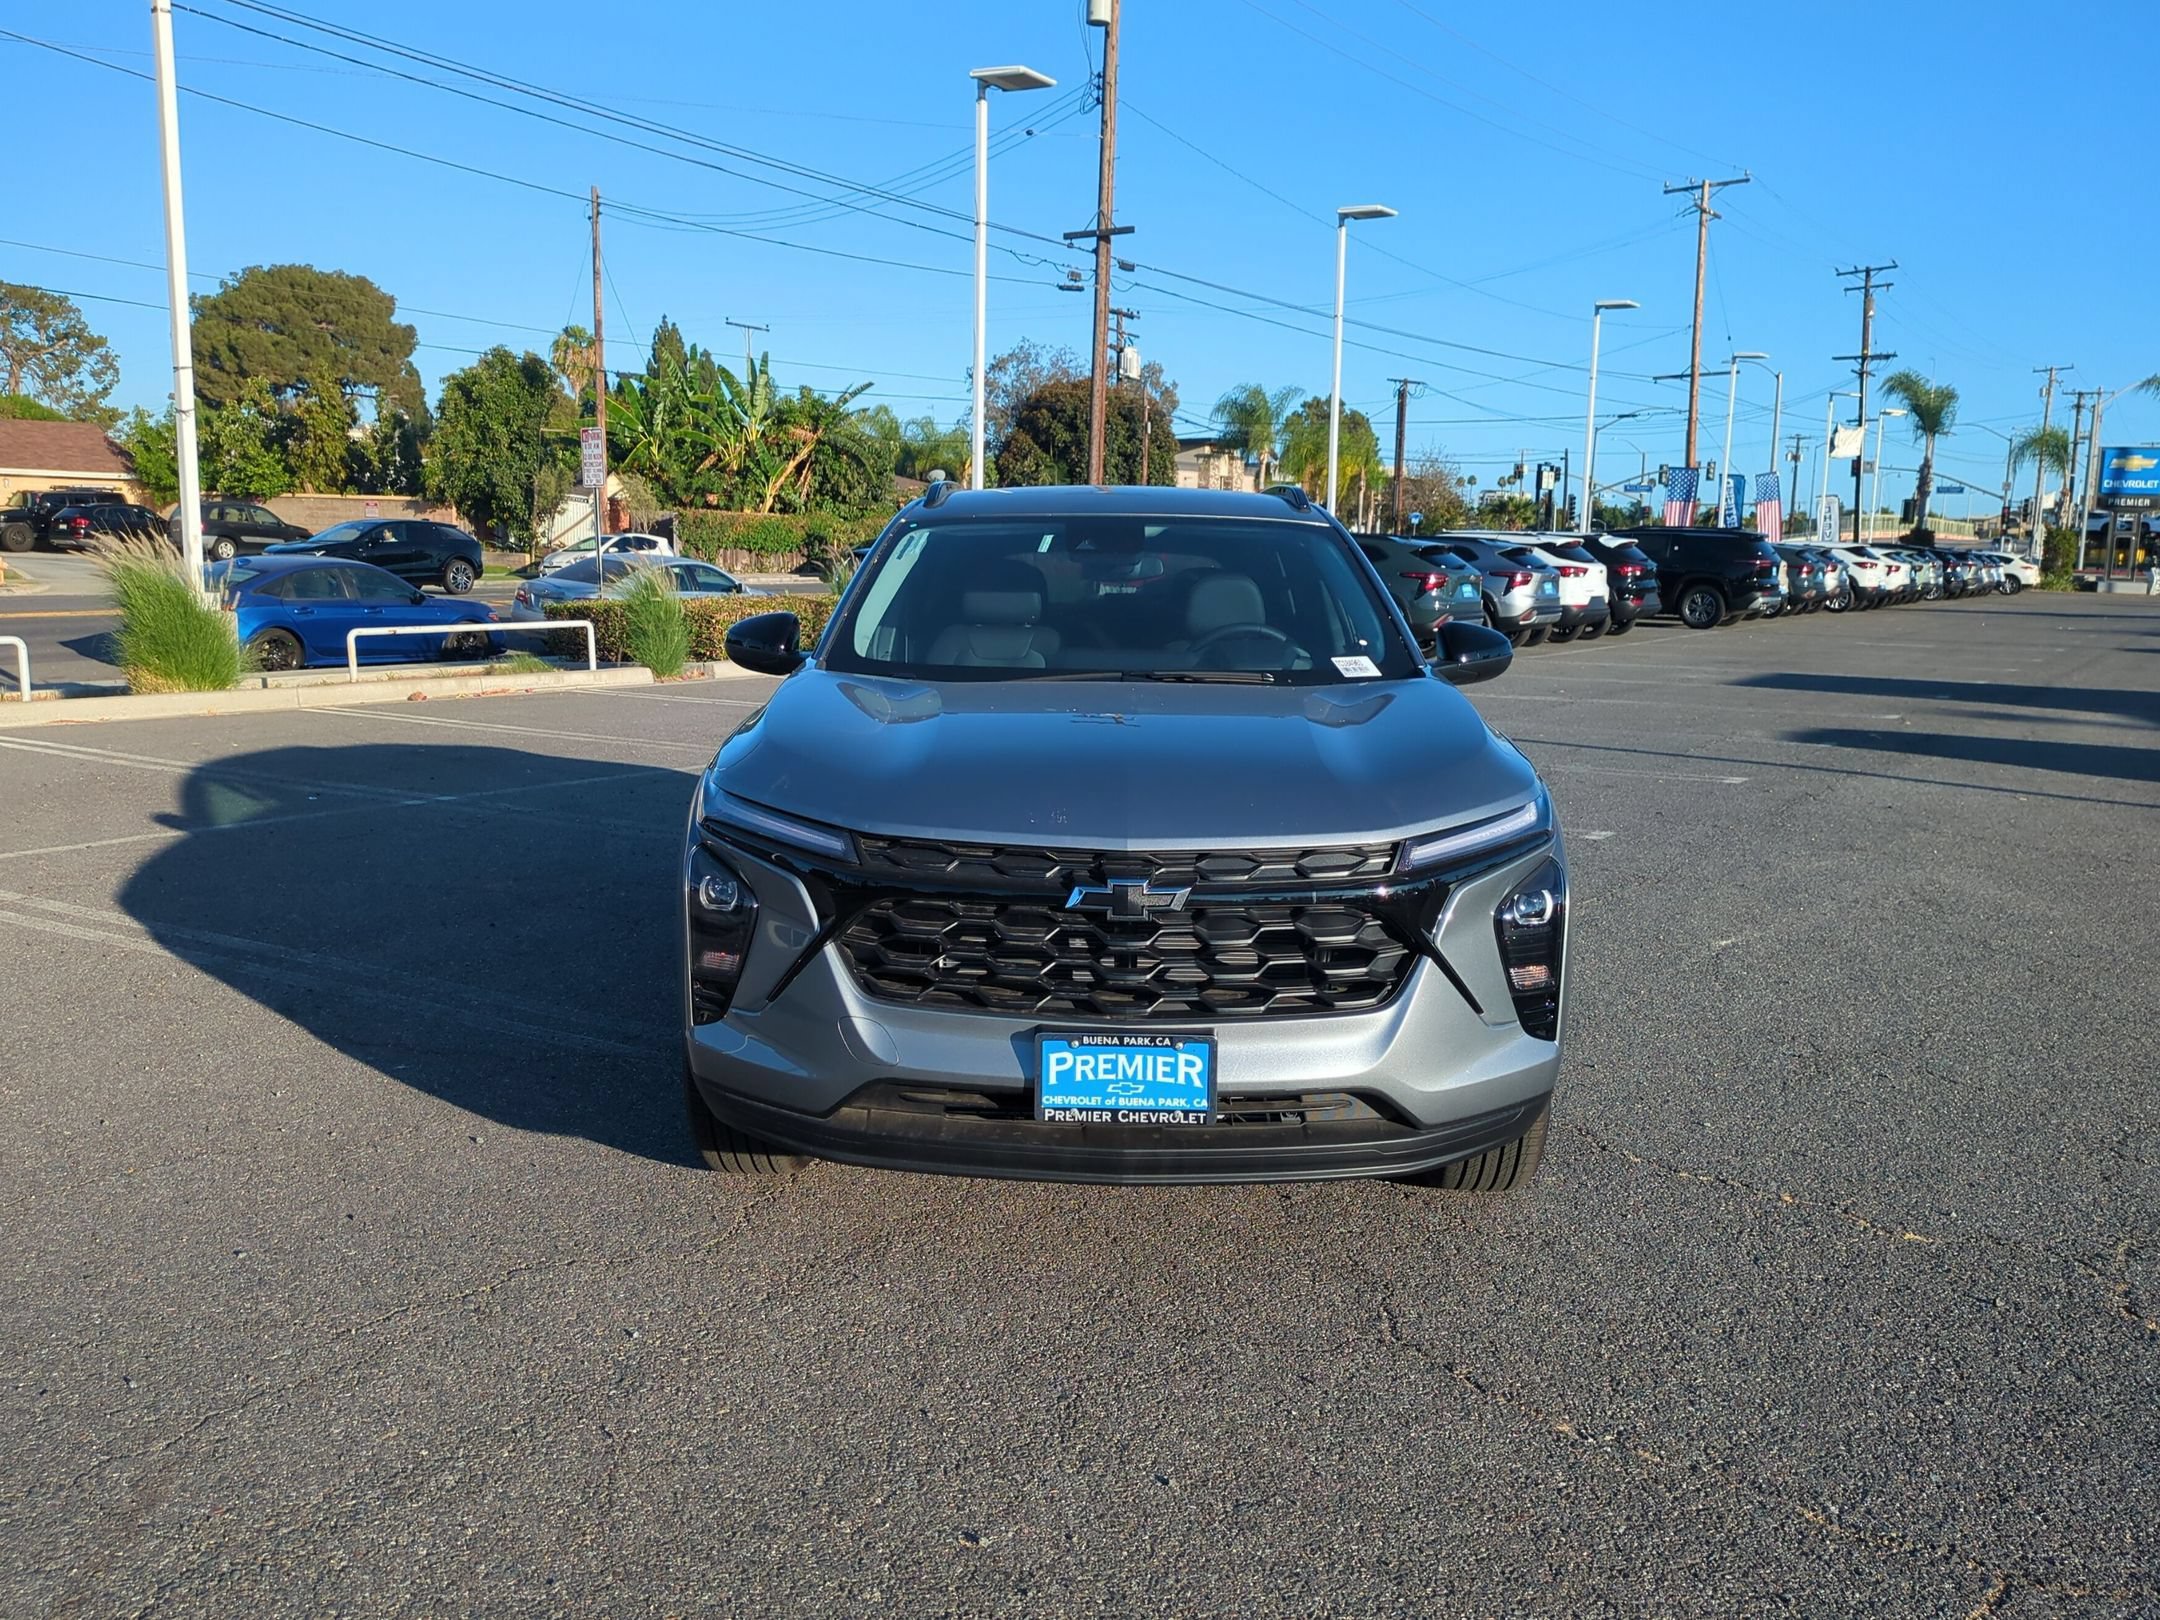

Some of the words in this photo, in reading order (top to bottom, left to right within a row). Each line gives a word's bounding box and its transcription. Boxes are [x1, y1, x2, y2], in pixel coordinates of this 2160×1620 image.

[2104, 479, 2159, 488] CHEVROLET
[2108, 498, 2150, 507] PREMIER
[1083, 1035, 1120, 1045] BUENA
[1123, 1036, 1155, 1047] PARK,
[1155, 1037, 1171, 1046] CA
[1048, 1051, 1204, 1088] PREMIER
[1042, 1095, 1102, 1105] CHEVROLET
[1104, 1096, 1116, 1106] of
[1118, 1097, 1156, 1107] BUENA
[1158, 1097, 1191, 1108] PARK,
[1193, 1098, 1208, 1108] CA
[1044, 1108, 1112, 1122] PREMIER
[1118, 1109, 1207, 1124] CHEVROLET
